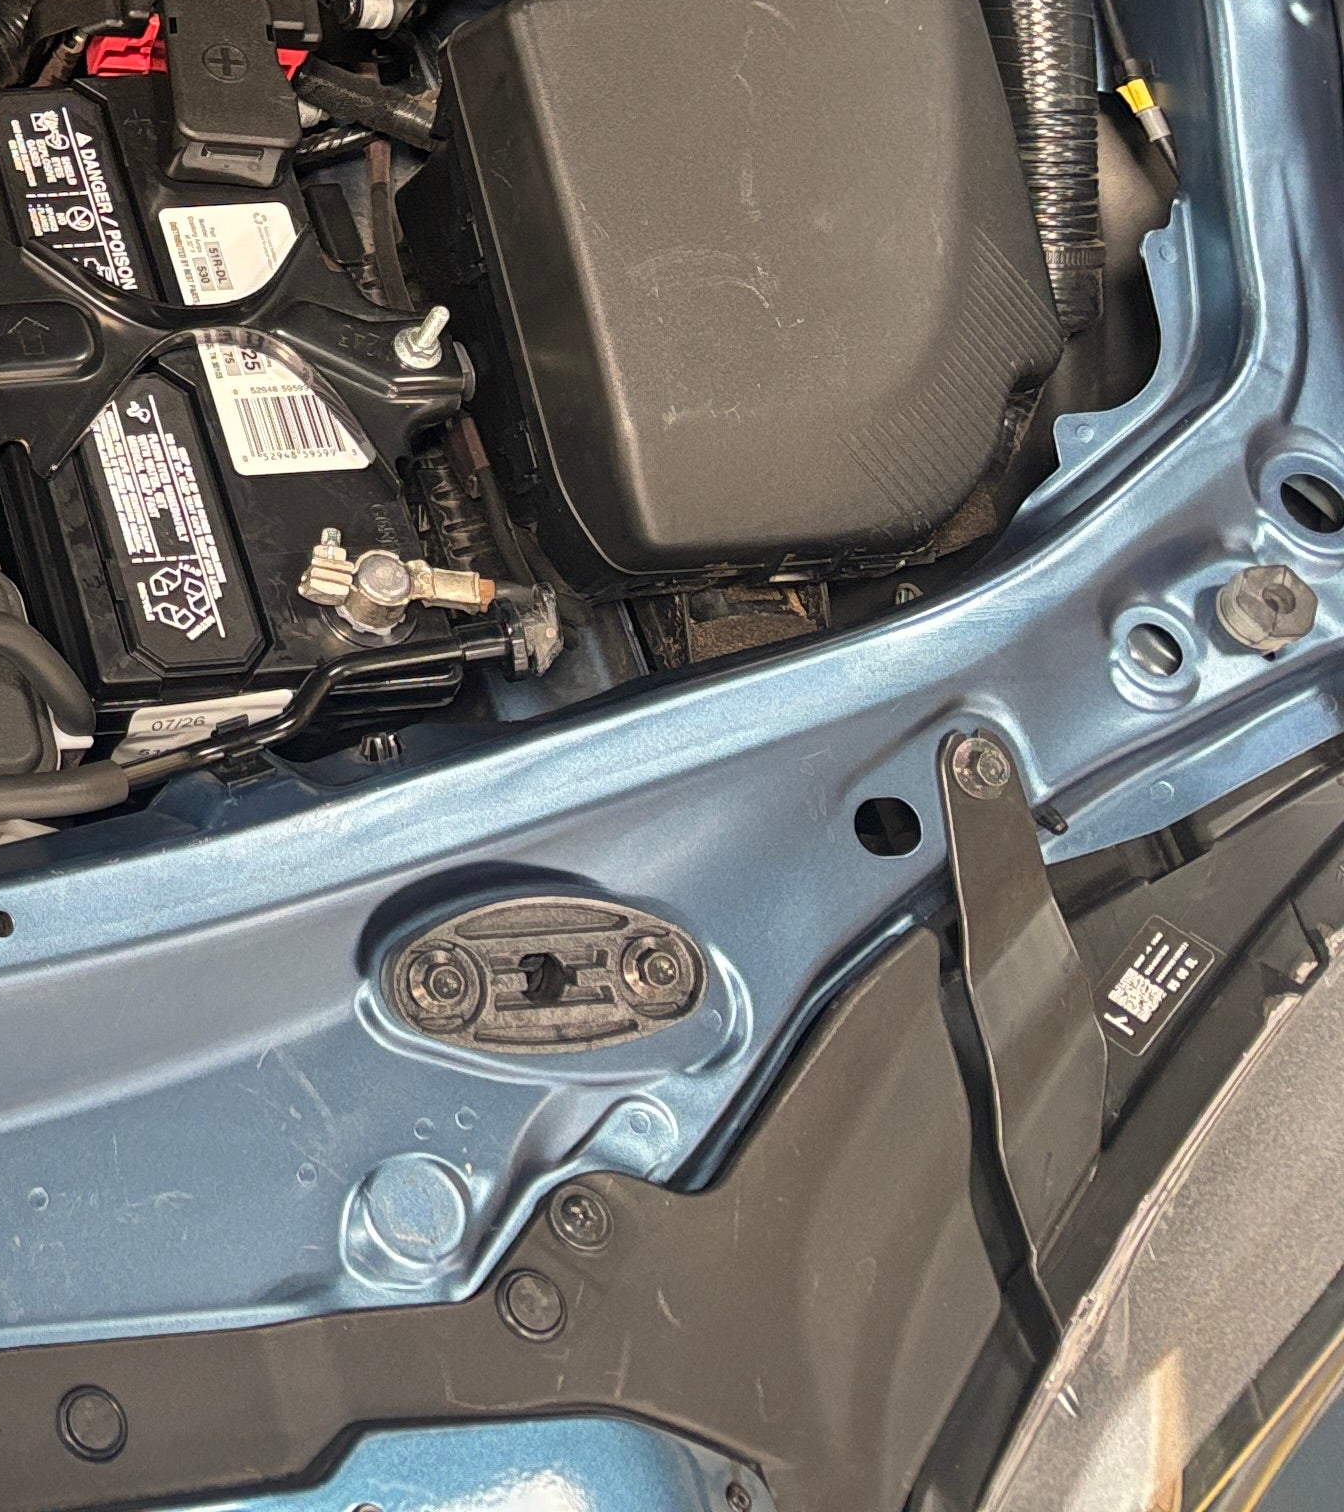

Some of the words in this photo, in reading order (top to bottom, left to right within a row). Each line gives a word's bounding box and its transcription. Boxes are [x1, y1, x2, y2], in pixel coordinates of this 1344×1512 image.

[79, 149, 113, 213] DANGER
[105, 229, 138, 291] POISON
[196, 265, 210, 284] 530
[208, 247, 227, 285] 51R-DL
[222, 351, 236, 365] 75
[251, 385, 278, 394] 52948
[261, 448, 299, 463] 52948
[301, 447, 338, 460] 59599
[151, 715, 206, 732] 07/26
